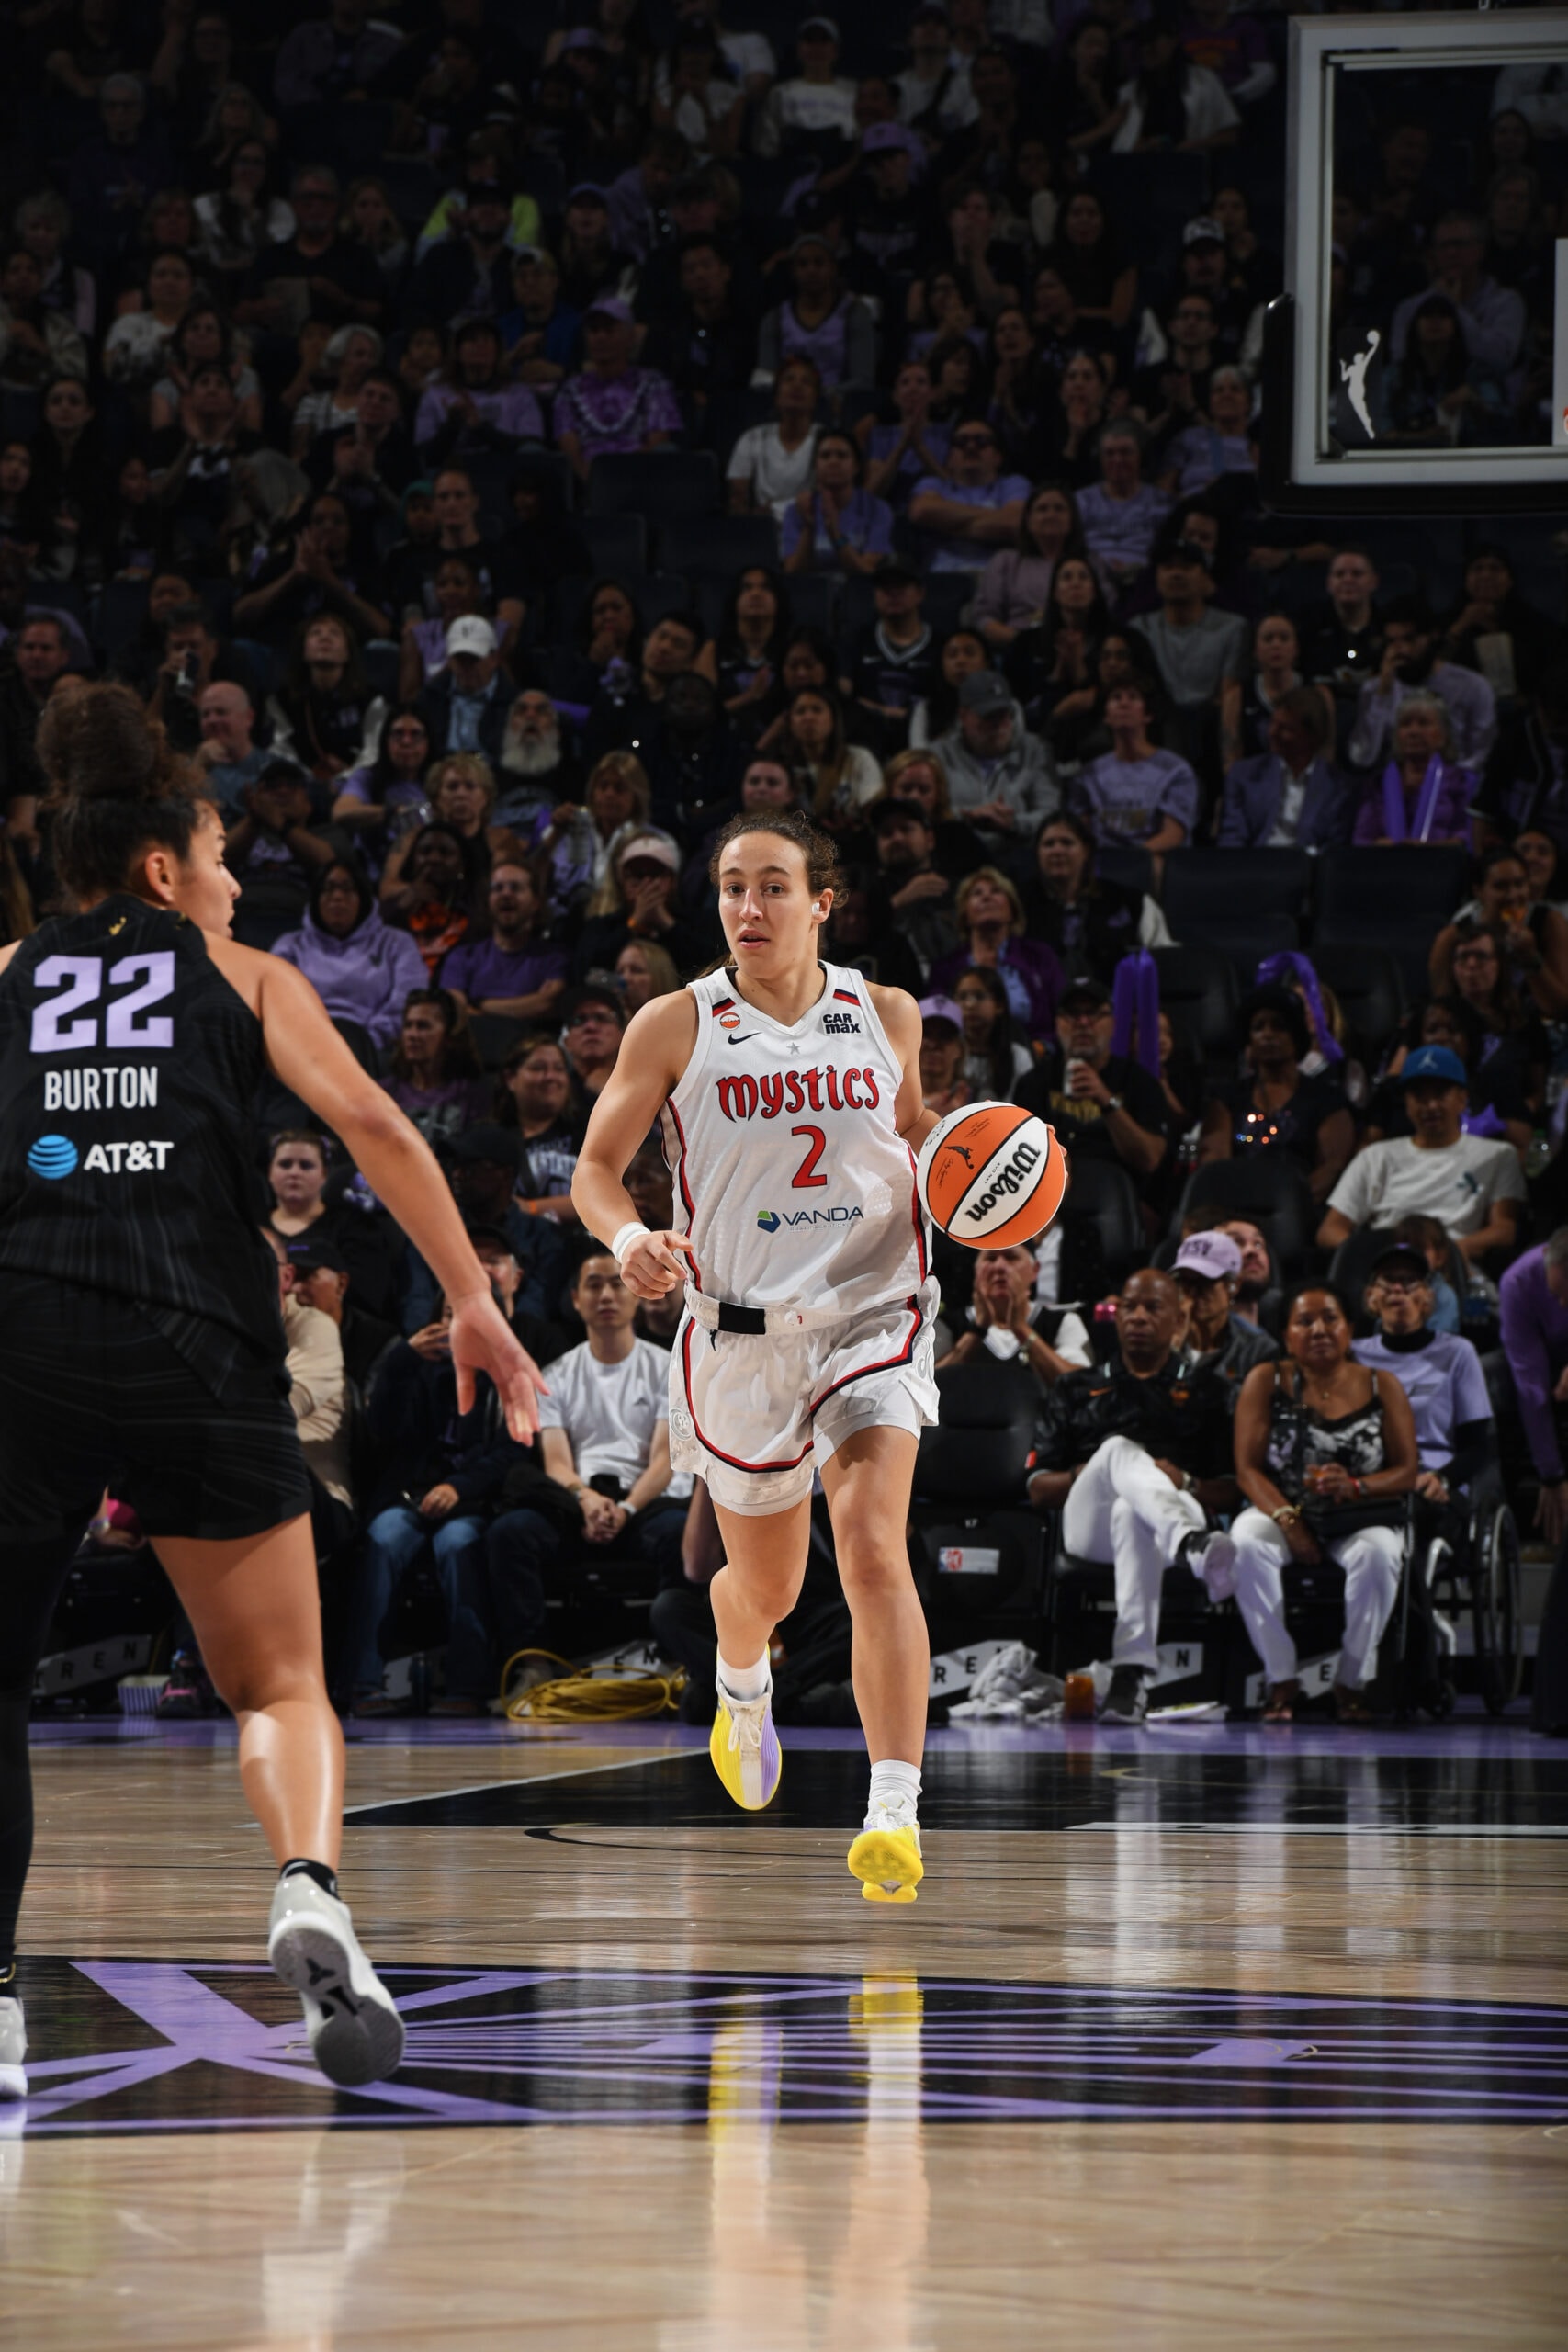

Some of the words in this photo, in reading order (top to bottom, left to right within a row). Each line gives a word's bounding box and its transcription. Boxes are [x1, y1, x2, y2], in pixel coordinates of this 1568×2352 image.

[29, 950, 175, 1053] 22
[822, 1013, 852, 1023] CAR
[826, 1023, 861, 1035] max
[44, 1066, 158, 1111] BURTON
[716, 1065, 879, 1123] mystics
[83, 1140, 175, 1174] AT&T
[791, 1125, 828, 1188] 2
[964, 1141, 1043, 1222] Wilson
[782, 1206, 864, 1226] VANDA
